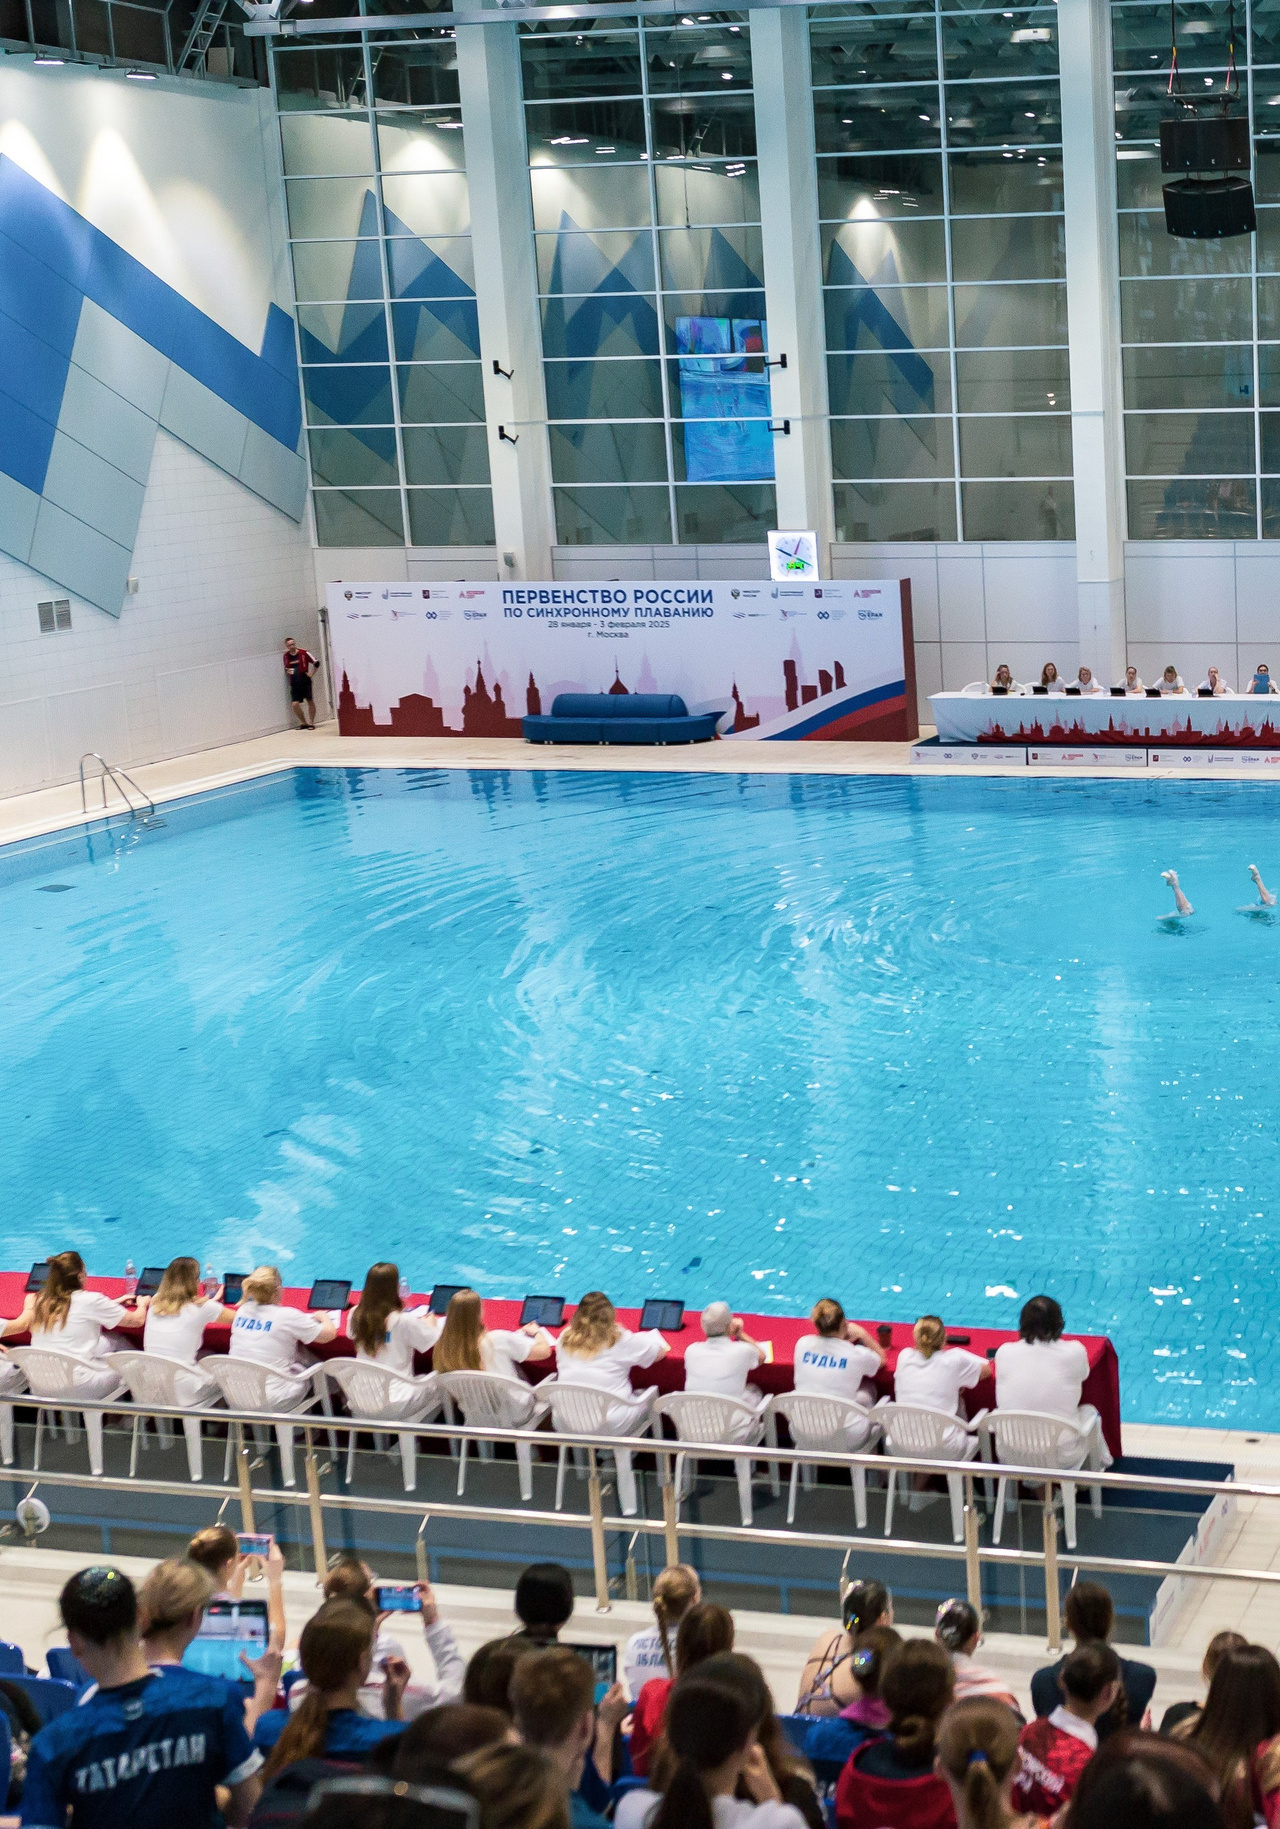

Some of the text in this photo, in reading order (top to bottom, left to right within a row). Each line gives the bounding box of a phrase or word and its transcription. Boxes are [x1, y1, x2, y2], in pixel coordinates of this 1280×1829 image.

[502, 590, 627, 604] ПЕРВЕНСТВО
[634, 589, 714, 604] РОССИИ
[504, 608, 714, 618] ПО СИНХРОННОМУ ПЛАВАНИЮ
[607, 621, 646, 629] февраля
[597, 631, 629, 639] Москва
[803, 1351, 847, 1369] СУДЬЯ
[75, 1733, 206, 1792] ТАТАРСТАН
